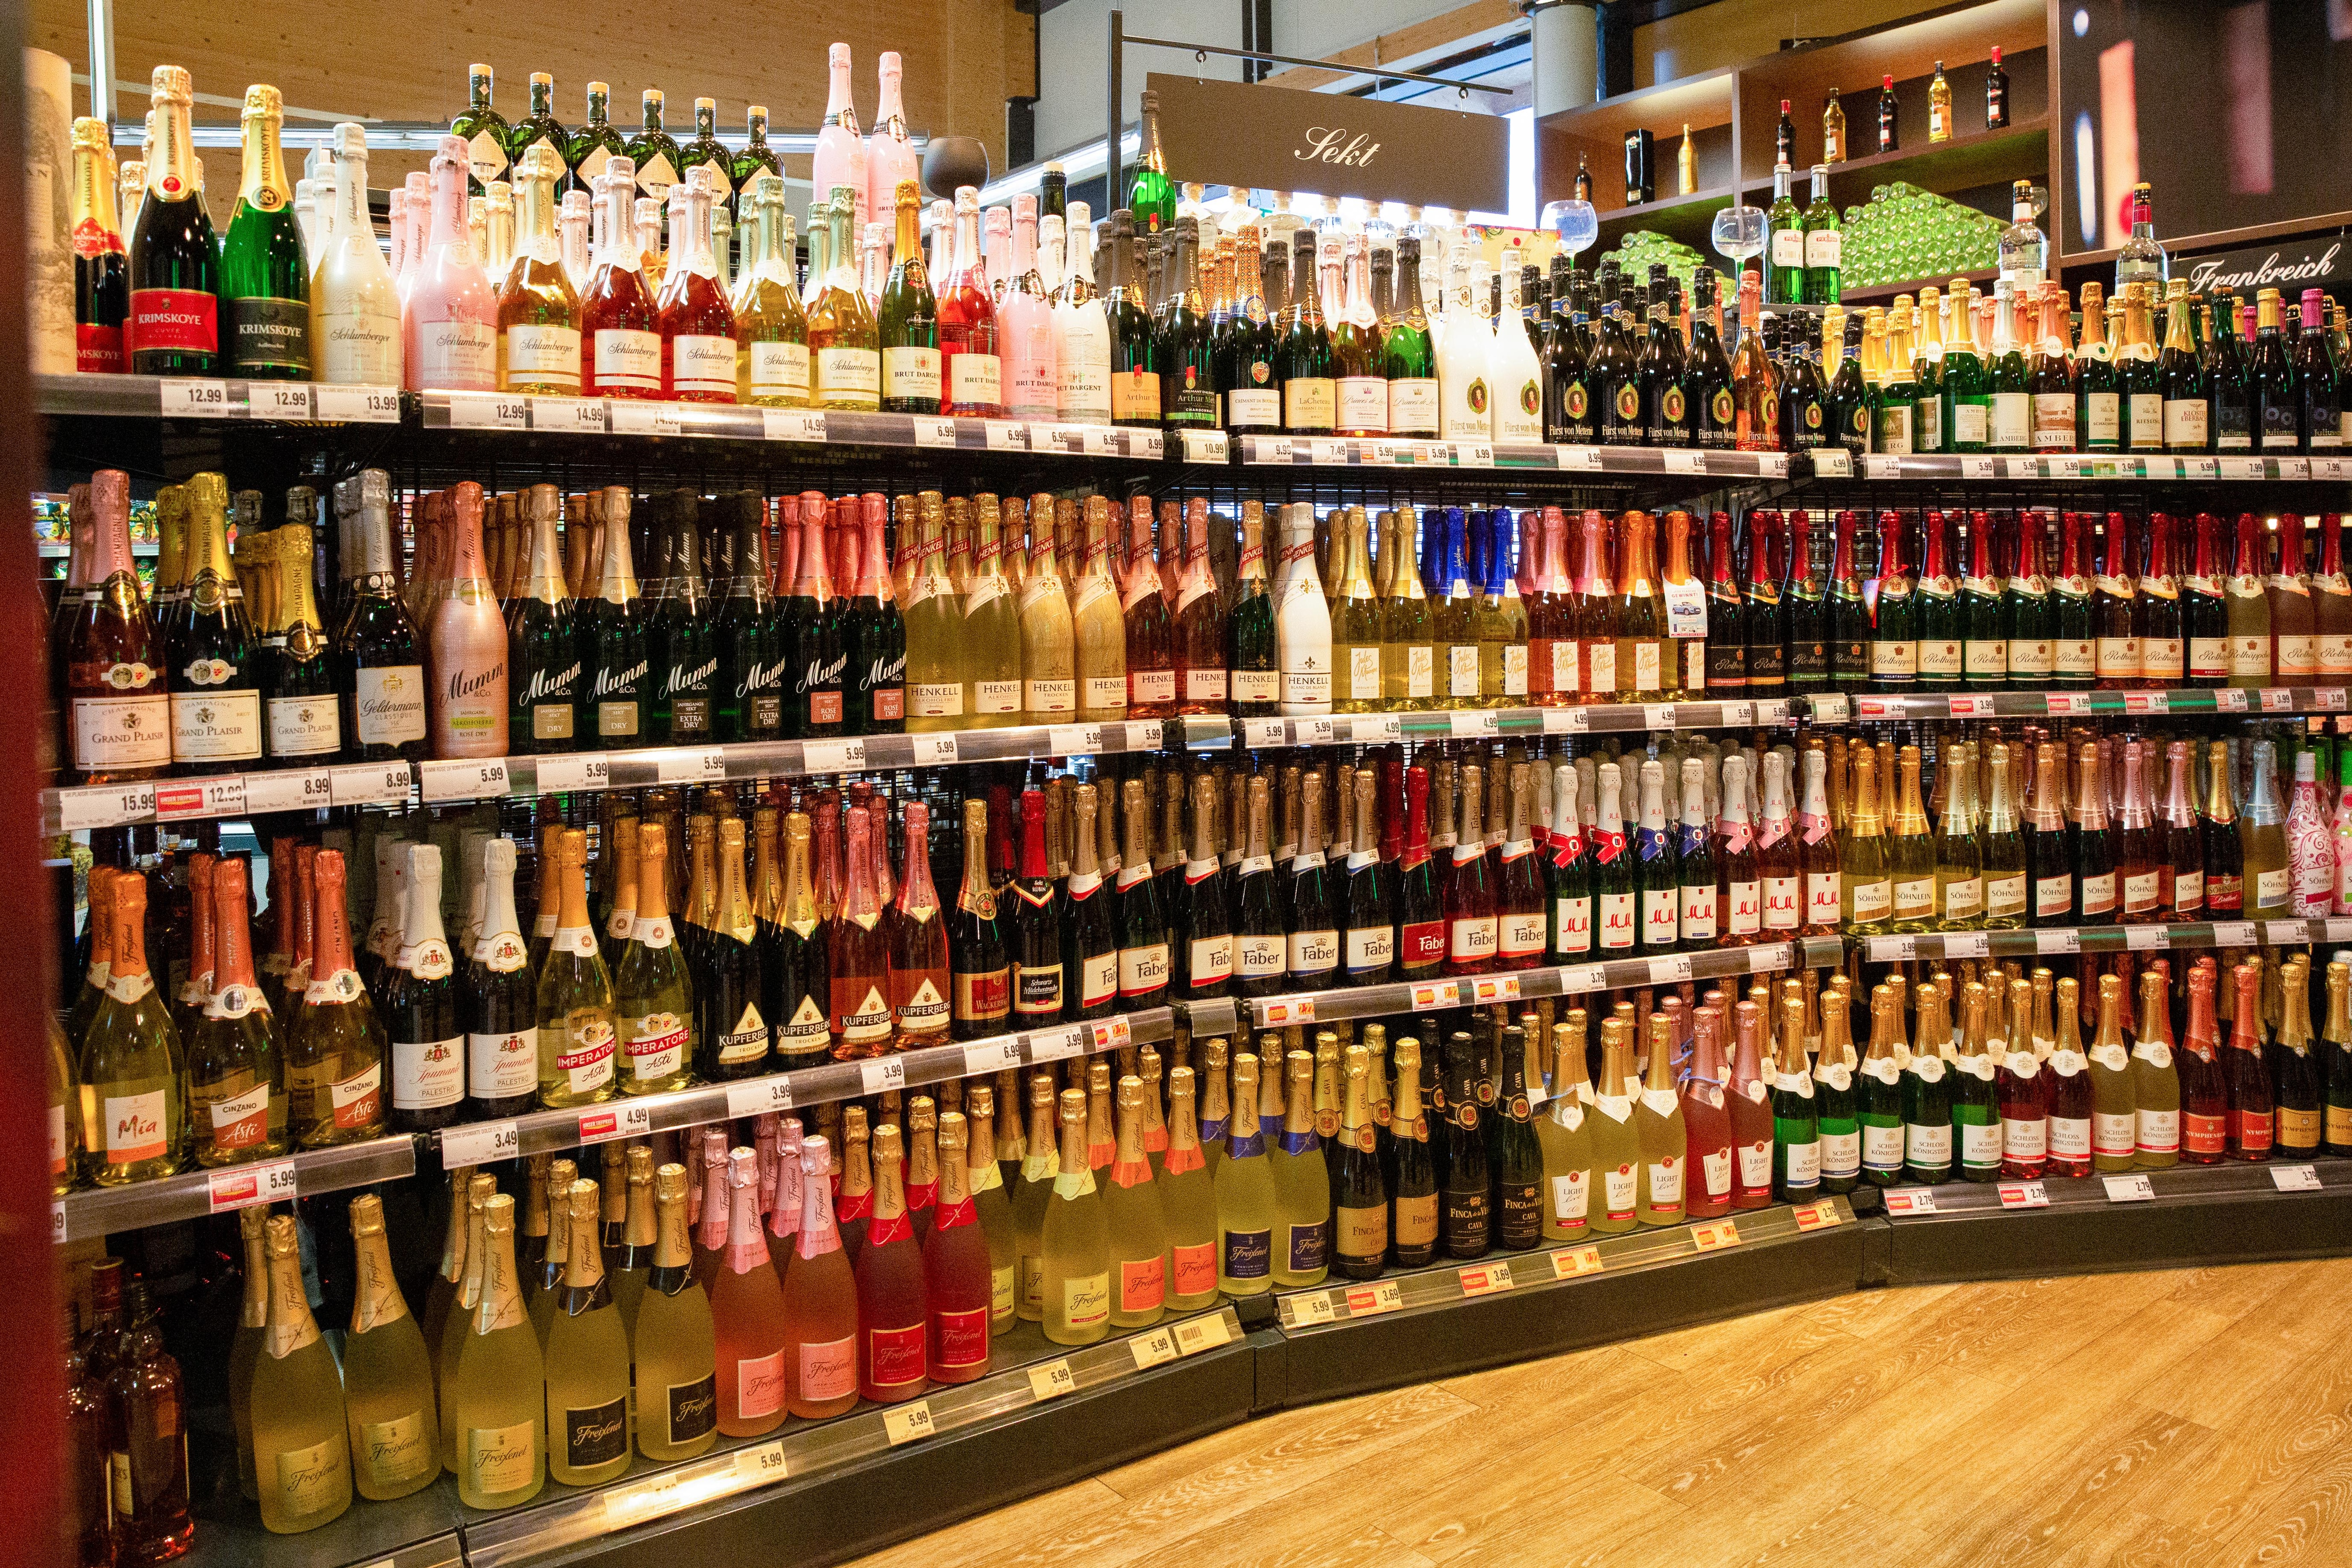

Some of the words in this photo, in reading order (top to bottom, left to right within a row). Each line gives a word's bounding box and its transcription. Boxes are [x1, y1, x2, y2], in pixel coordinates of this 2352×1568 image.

[1294, 127, 1381, 167] Sekt
[2190, 243, 2342, 293] Frankreich
[138, 313, 201, 325] KRIMSKOYE
[239, 325, 302, 337] KRIMSKOYE
[330, 329, 390, 343] Schlumberger
[437, 334, 490, 349] Schlumberger
[608, 342, 657, 357] Schlumberger
[763, 354, 807, 369] Schlumberger
[830, 359, 875, 373] Schlumberger
[189, 388, 222, 403] 12.99
[367, 396, 397, 410] 13.99
[496, 404, 524, 419] 12.99
[576, 407, 603, 421] 14.99
[803, 419, 826, 432] 14.99
[938, 425, 955, 438] 6.99
[1549, 424, 1562, 436] Fürst
[1602, 425, 1614, 436] Fürst
[1698, 428, 1711, 439] Fürst
[1148, 438, 1162, 450] 8.99
[1205, 443, 1224, 454] 10.99
[1330, 445, 1346, 456] 7.49
[1379, 446, 1394, 457] 5.99
[1476, 449, 1490, 459] 8.99
[1834, 459, 1845, 468] 4.99
[1979, 462, 1992, 471] 5.99
[2122, 463, 2135, 472] 3.99
[2201, 462, 2214, 472] 9.99
[519, 661, 581, 706] Mumm
[659, 657, 717, 700] Mumm
[736, 656, 785, 698] Mumm
[1288, 676, 1328, 685] HENKELL
[440, 663, 503, 706] Mumm
[911, 687, 958, 696] HENKELL
[1034, 683, 1074, 692] HENKELL
[102, 705, 156, 715] CHAMPAGNE
[181, 701, 231, 710] CHAMPAGNE
[361, 698, 423, 717] Geldermann
[1980, 700, 1993, 710] 3.99
[1738, 709, 1751, 719] 5.99
[278, 726, 304, 735] GRAND
[307, 724, 333, 733] PLAISIR
[1484, 717, 1497, 728] 4.99
[92, 733, 131, 744] GRAND
[134, 731, 165, 741] PLAISIR
[175, 728, 204, 737] GRAND
[207, 726, 242, 736] PLAISIR
[1086, 733, 1101, 744] 5.99
[1266, 726, 1282, 737] 5.99
[704, 755, 723, 769] 5.99
[386, 773, 409, 788] 8.99
[481, 767, 503, 782] 5.99
[305, 778, 329, 794] 8.99
[121, 793, 155, 811] 15.99
[1858, 894, 1890, 903] SÖHNLEIN
[1896, 891, 1931, 901] SÖHNLEIN
[1468, 932, 1496, 946] Faber
[1514, 927, 1544, 942] Faber
[1302, 946, 1335, 961] Faber
[1901, 942, 1915, 952] 3.99
[1243, 950, 1279, 965] Faber
[1136, 962, 1168, 979] Faber
[1591, 972, 1605, 983] 3.79
[1023, 985, 1058, 995] Mädchentraube
[898, 1001, 951, 1015] KUPFERBERG
[1298, 1004, 1314, 1015] 2.22
[777, 1020, 830, 1036] KUPFERBERG
[625, 1028, 690, 1053] IMPERATORE
[719, 1026, 768, 1046] KUPFERBER
[1066, 1034, 1081, 1047] 3.99
[1004, 1044, 1019, 1058] 6.99
[485, 1051, 535, 1074] Spumante
[646, 1052, 673, 1070] Asti
[410, 1061, 460, 1083] Spumante
[581, 1061, 607, 1082] Asti
[344, 1081, 373, 1093] CINZANO
[497, 1077, 529, 1085] PALESTRO
[421, 1086, 454, 1097] PALESTRO
[772, 1085, 791, 1100] 3.99
[223, 1103, 256, 1113] CINZANO
[347, 1101, 376, 1120] Asti
[596, 1117, 613, 1126] TIEFPREIS
[627, 1109, 647, 1124] 4.99
[225, 1123, 261, 1142] Asti
[495, 1131, 517, 1147] 3.49
[270, 1170, 295, 1189] 5.99
[2303, 1171, 2318, 1181] 3.79
[1918, 1195, 1933, 1205] 2.79
[2030, 1188, 2045, 1199] 2.79
[1450, 1207, 1472, 1219] FINCA
[1353, 1226, 1374, 1235] FINCA
[1229, 1246, 1268, 1262] Freixenet
[1494, 1268, 1510, 1282] 3.69
[1071, 1291, 1107, 1311] Freixenet
[943, 1328, 983, 1349] Freixenet
[1051, 1368, 1069, 1385] 5.99
[909, 1411, 929, 1428] 5.99
[573, 1417, 622, 1446] Freixenet
[476, 1445, 527, 1468] Freixenet
[761, 1452, 782, 1469] 5.99
[288, 1458, 339, 1491] Freixenet
